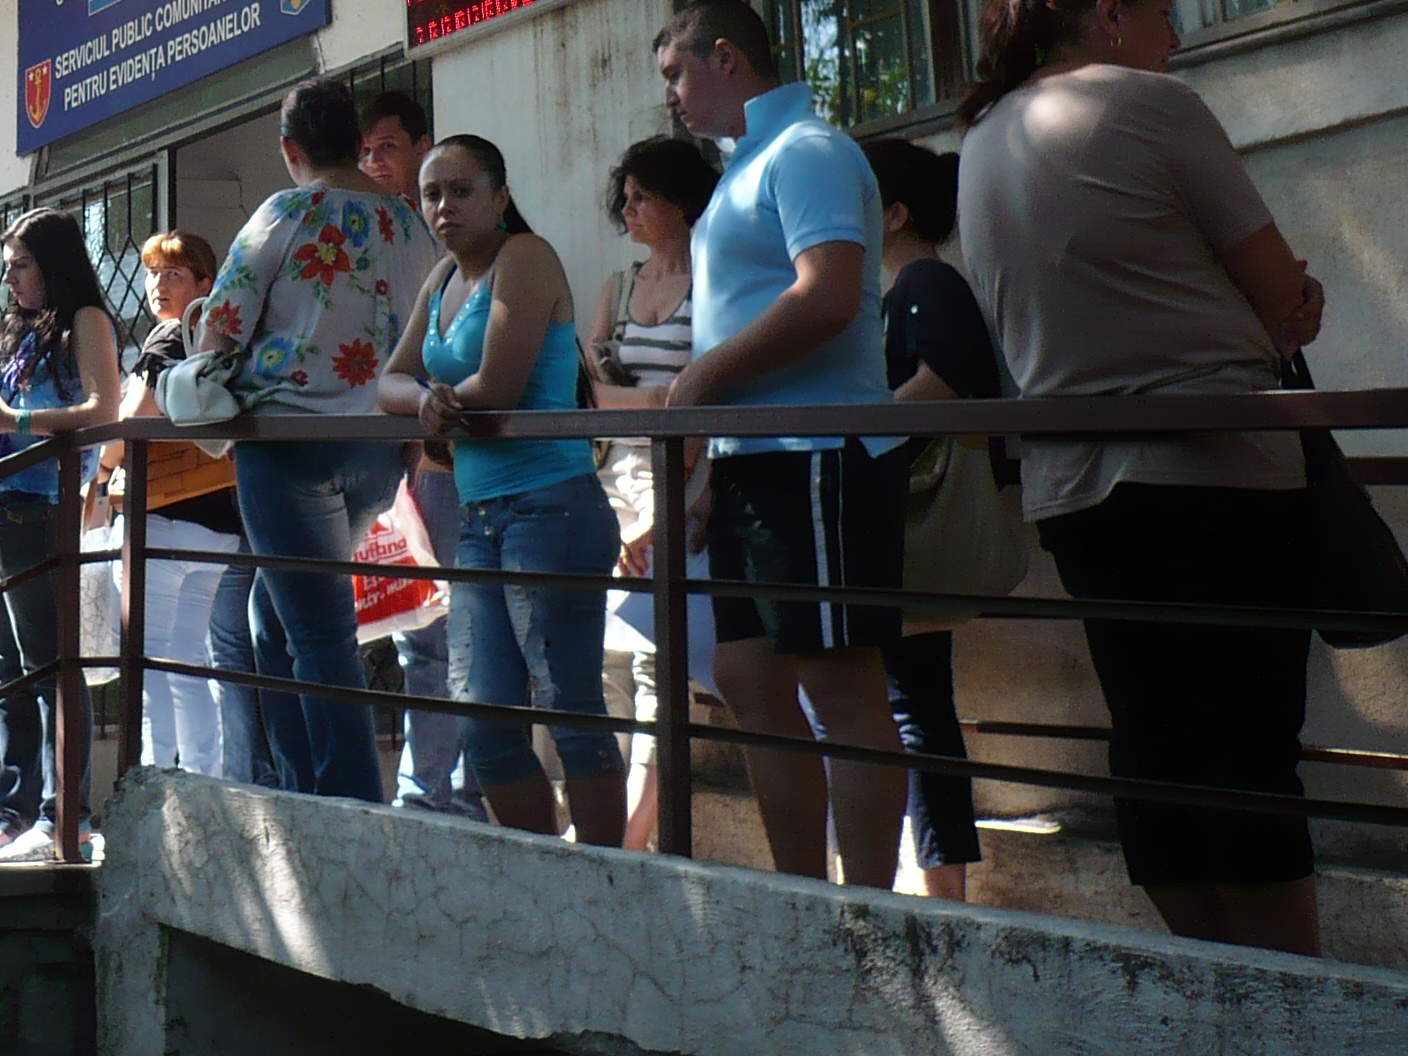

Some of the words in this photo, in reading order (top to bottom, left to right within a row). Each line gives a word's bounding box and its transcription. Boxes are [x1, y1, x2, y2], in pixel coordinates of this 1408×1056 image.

[55, 33, 110, 80] SERVICIUL
[111, 11, 154, 53] PUBLIC
[64, 70, 108, 112] PENTRU
[109, 44, 166, 91] EVIDENȚA
[167, 1, 261, 65] PERSOANELOR
